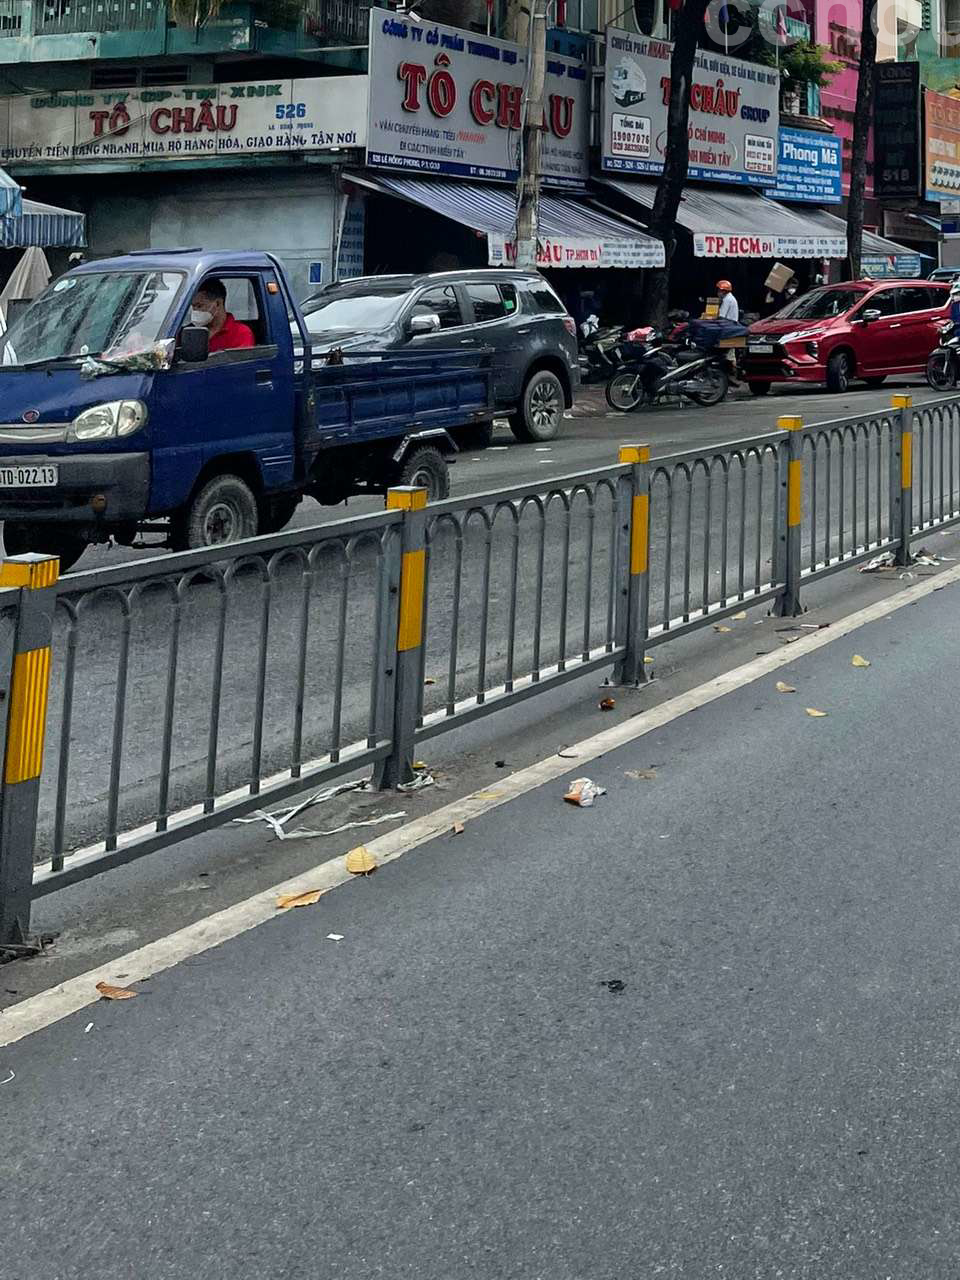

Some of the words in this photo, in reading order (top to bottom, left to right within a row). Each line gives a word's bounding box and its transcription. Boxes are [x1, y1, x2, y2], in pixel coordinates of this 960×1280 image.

[411, 26, 424, 41] TY
[230, 84, 282, 98] XNK
[398, 52, 458, 118] TÔ
[470, 78, 576, 140] CHU
[689, 78, 740, 118] CHÂU
[89, 102, 131, 137] TÔ
[150, 98, 239, 134] CHÂU
[275, 102, 306, 119] 526
[740, 105, 770, 123] GROUP
[143, 140, 165, 152] MUA
[246, 135, 273, 148] GIAO
[276, 131, 307, 147] HÀNG
[337, 130, 357, 144] NƠI
[613, 131, 650, 145] 19007076
[783, 142, 818, 166] Phong
[704, 236, 761, 254] TP.HCM
[0, 468, 54, 486] TD-022.13
